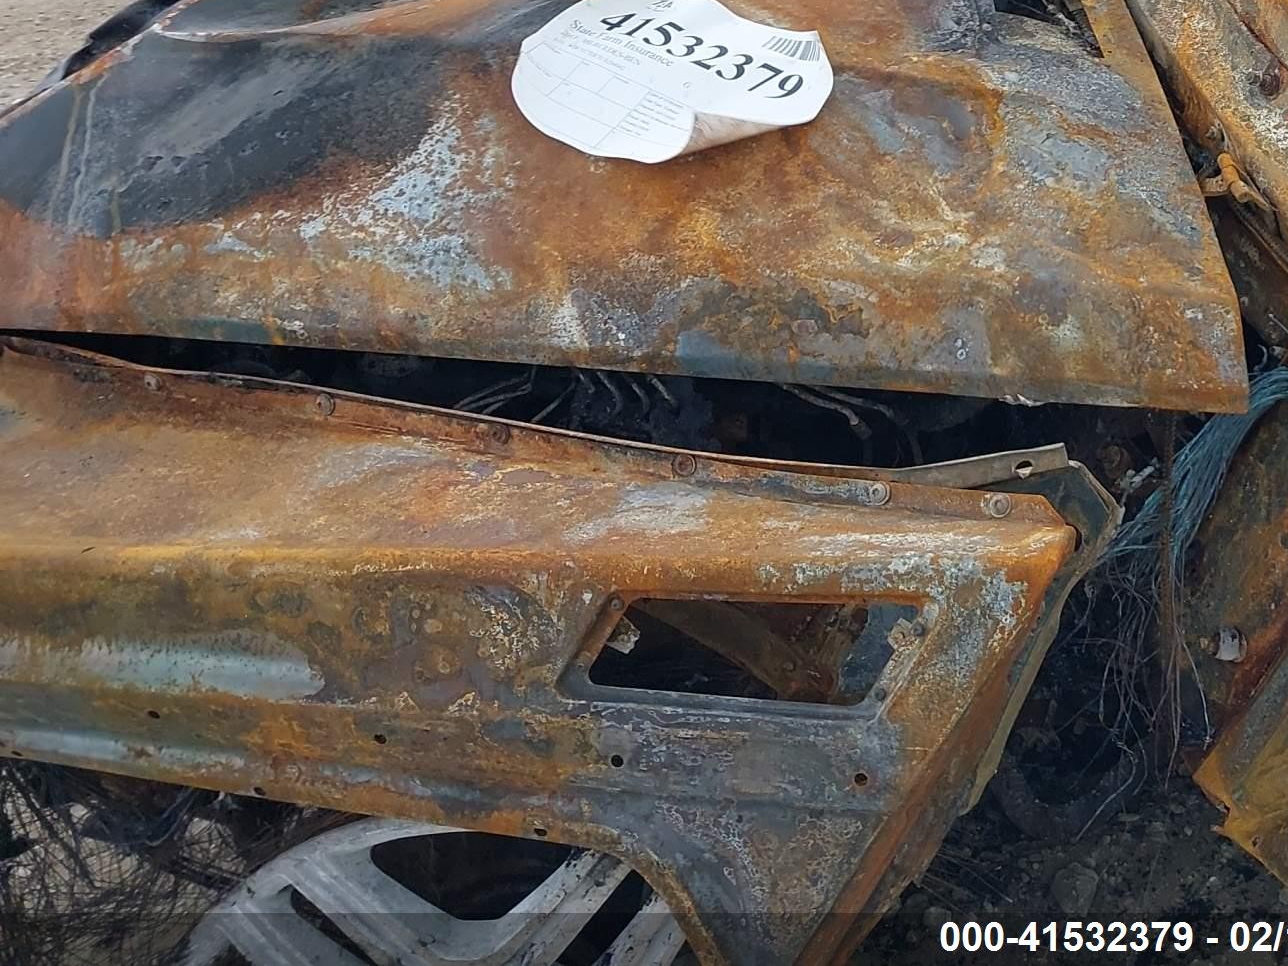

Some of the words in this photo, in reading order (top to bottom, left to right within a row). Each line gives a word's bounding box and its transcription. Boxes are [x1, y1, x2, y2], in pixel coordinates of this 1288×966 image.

[570, 19, 597, 37] State
[600, 32, 622, 45] Farm
[623, 40, 674, 66] Insurance
[600, 13, 804, 99] 41532379
